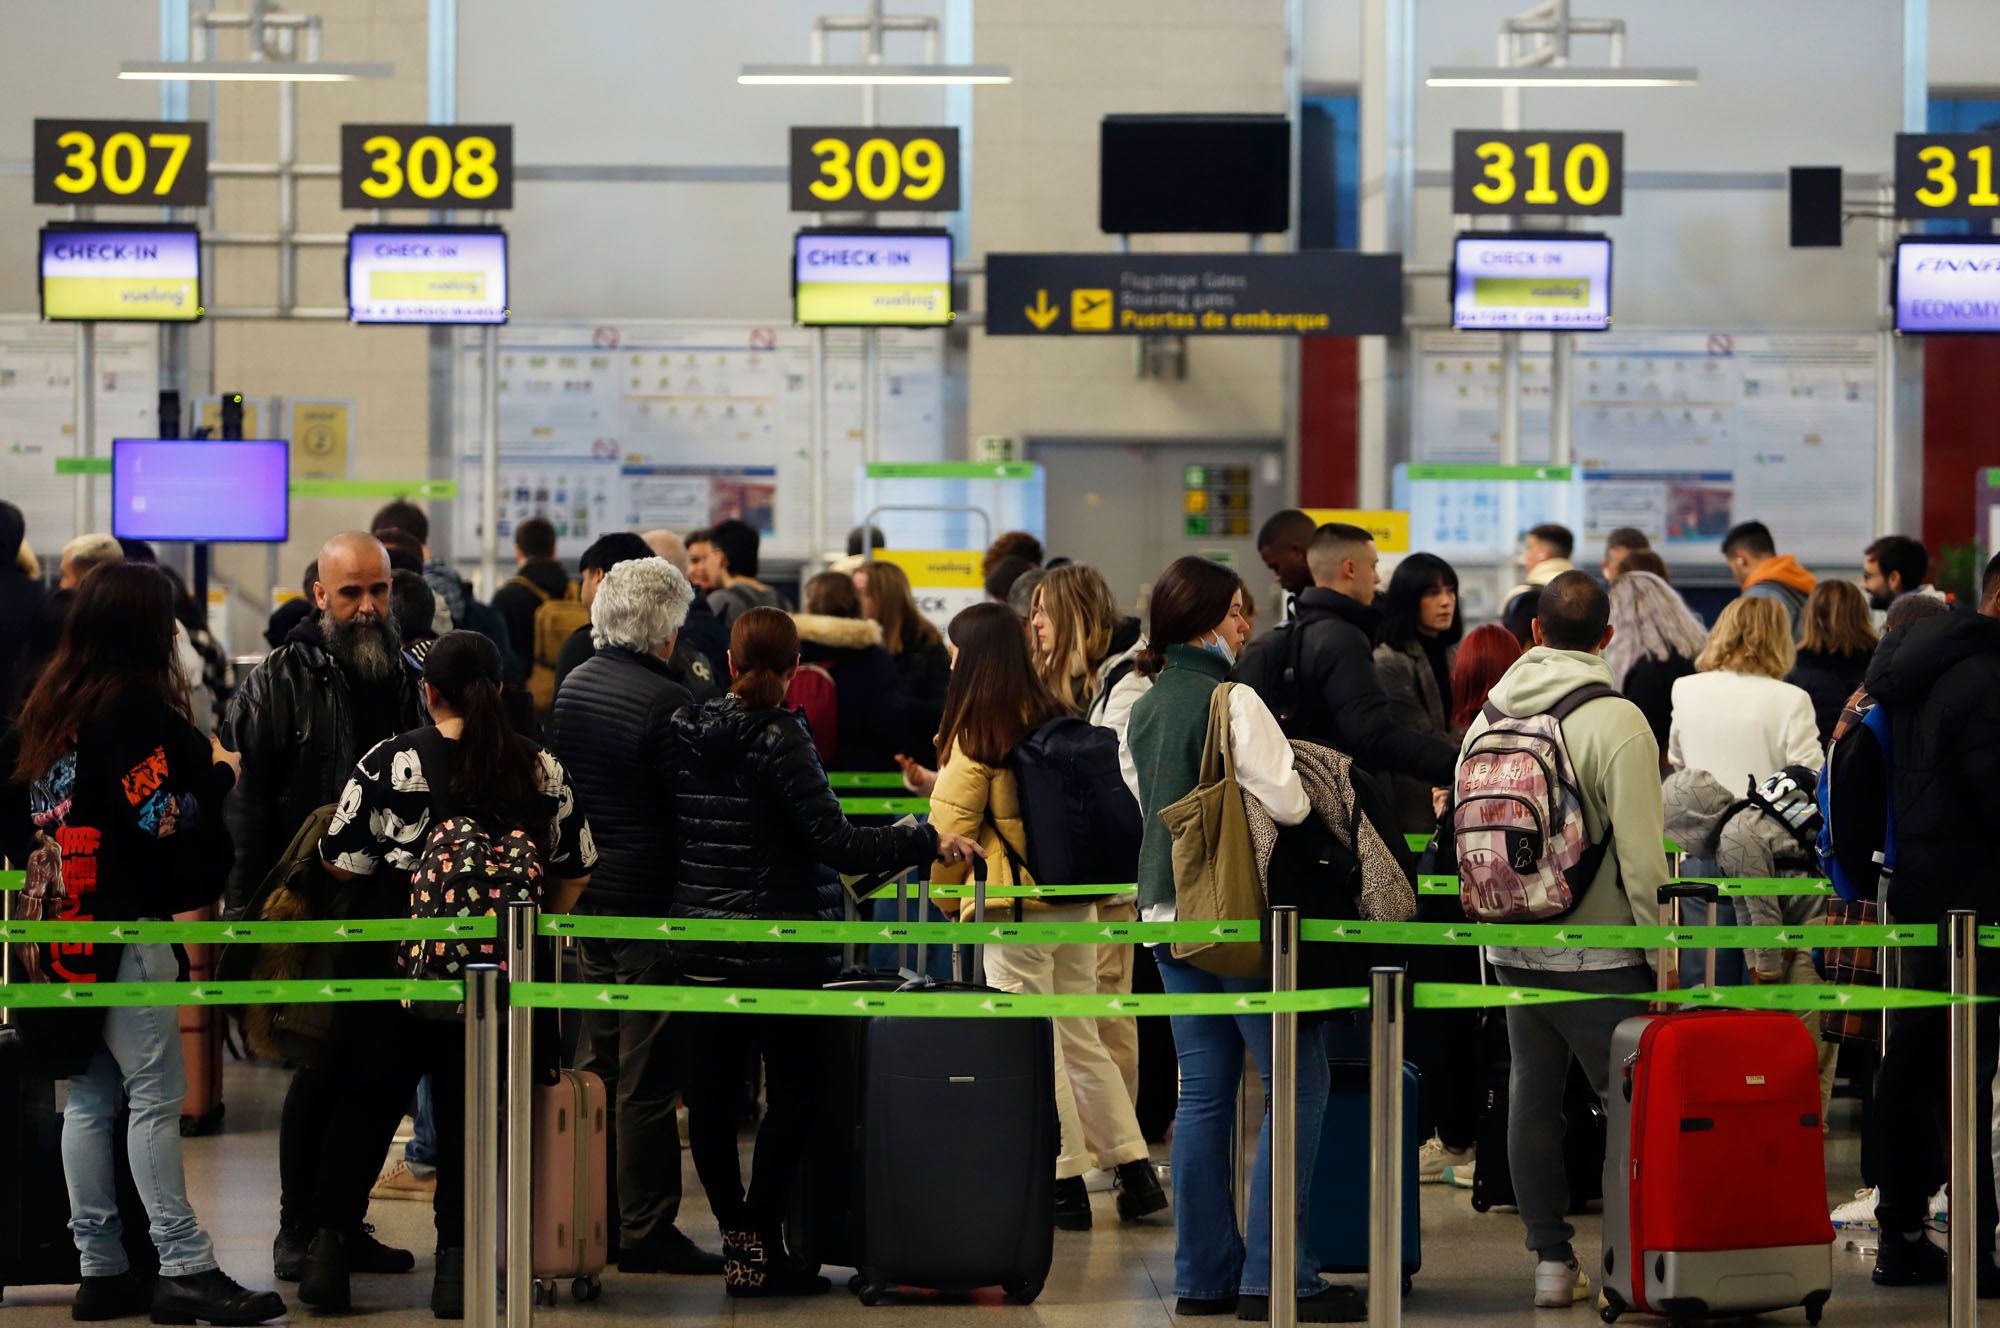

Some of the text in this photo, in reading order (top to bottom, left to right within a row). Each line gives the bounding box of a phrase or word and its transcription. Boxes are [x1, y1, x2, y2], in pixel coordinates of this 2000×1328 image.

[53, 131, 192, 195] 307
[360, 136, 499, 199] 308
[808, 138, 946, 201] 309
[1472, 142, 1610, 206] 310
[54, 243, 158, 260] CHECK-IN
[807, 249, 911, 266] CHECK-IN
[1121, 291, 1235, 309] Boarding gates
[1121, 310, 1330, 332] Puertas de embarque
